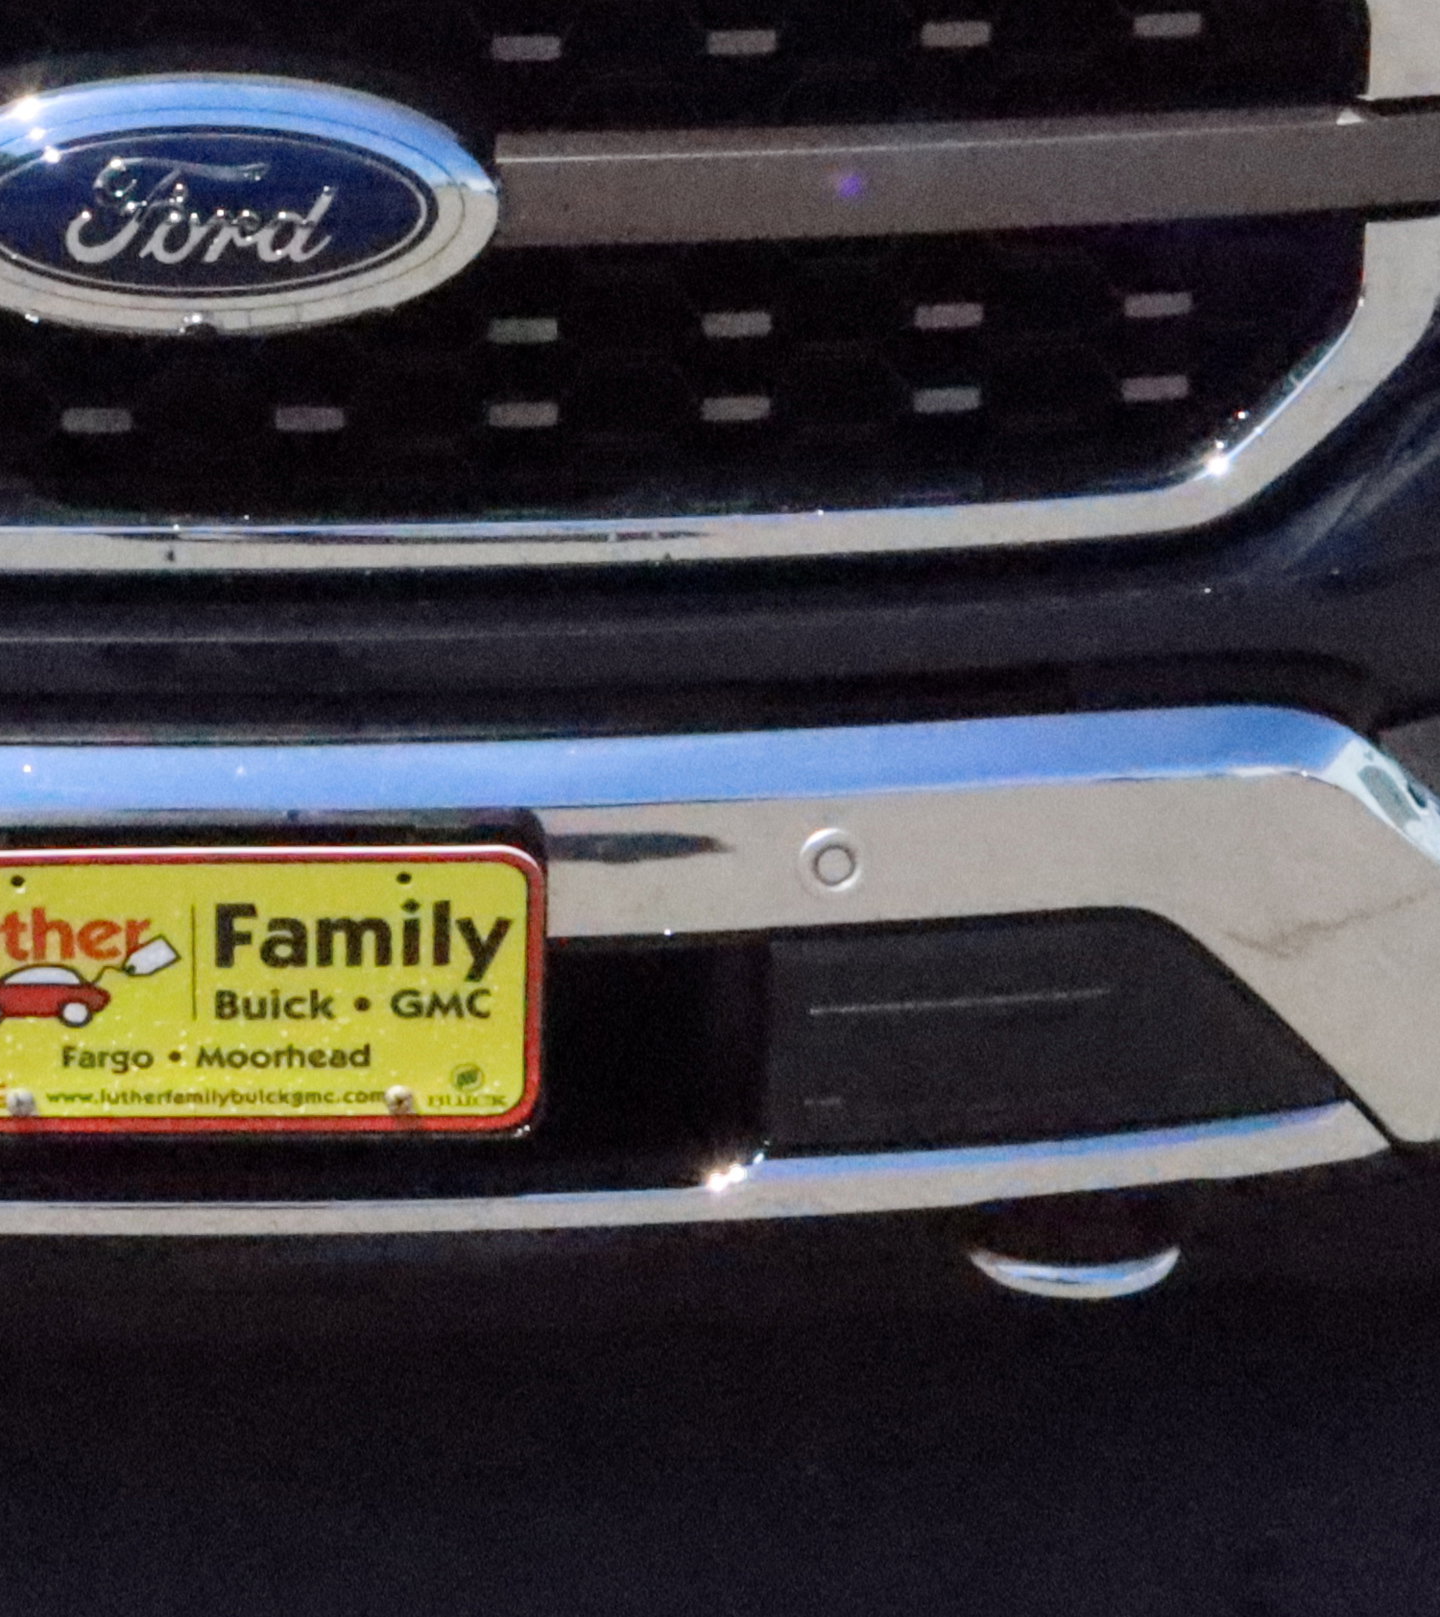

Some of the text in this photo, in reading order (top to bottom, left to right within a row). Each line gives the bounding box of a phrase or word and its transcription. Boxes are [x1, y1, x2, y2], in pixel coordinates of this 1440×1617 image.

[65, 157, 336, 264] Ford
[214, 899, 513, 982] Family
[215, 989, 491, 1021] Buick GMC
[61, 1044, 371, 1073] Fargo Moorhead
